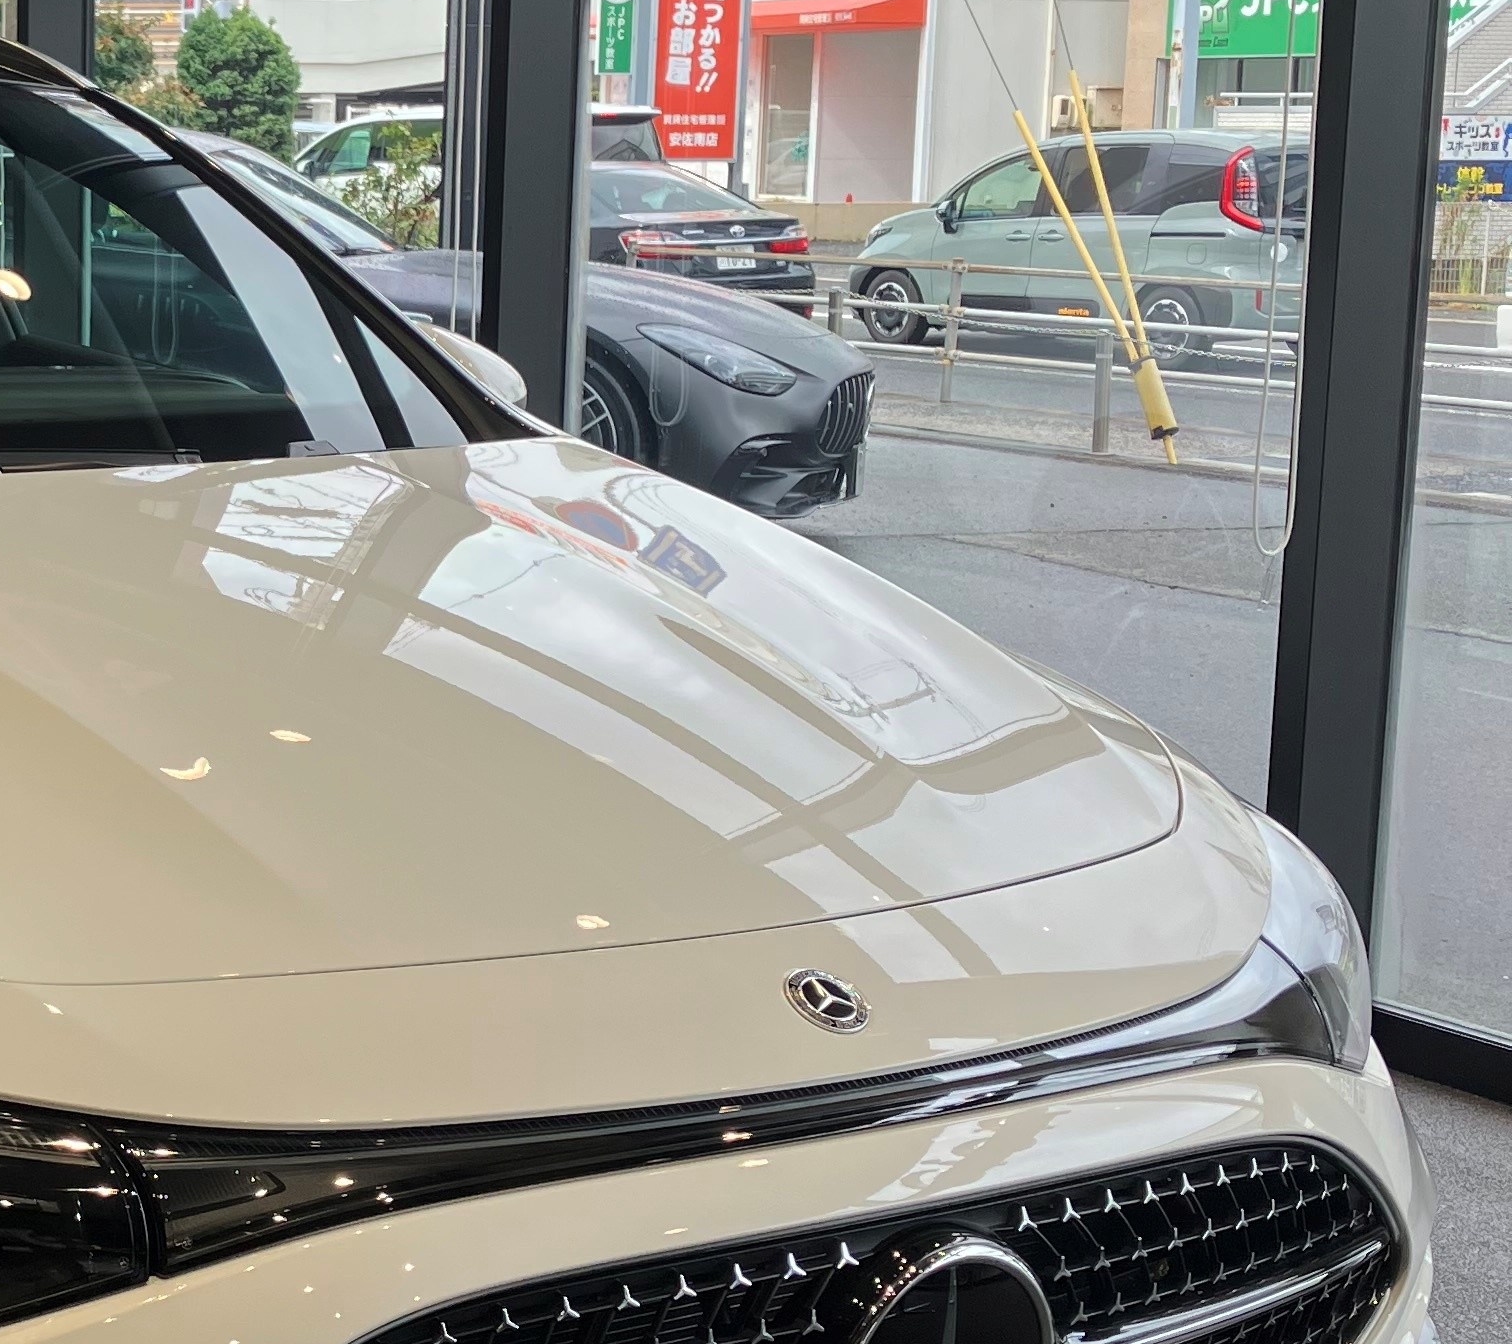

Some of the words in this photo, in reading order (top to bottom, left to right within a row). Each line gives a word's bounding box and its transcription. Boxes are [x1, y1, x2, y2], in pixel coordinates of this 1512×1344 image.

[617, 6, 626, 41] JPC
[1454, 123, 1492, 139] キッズ
